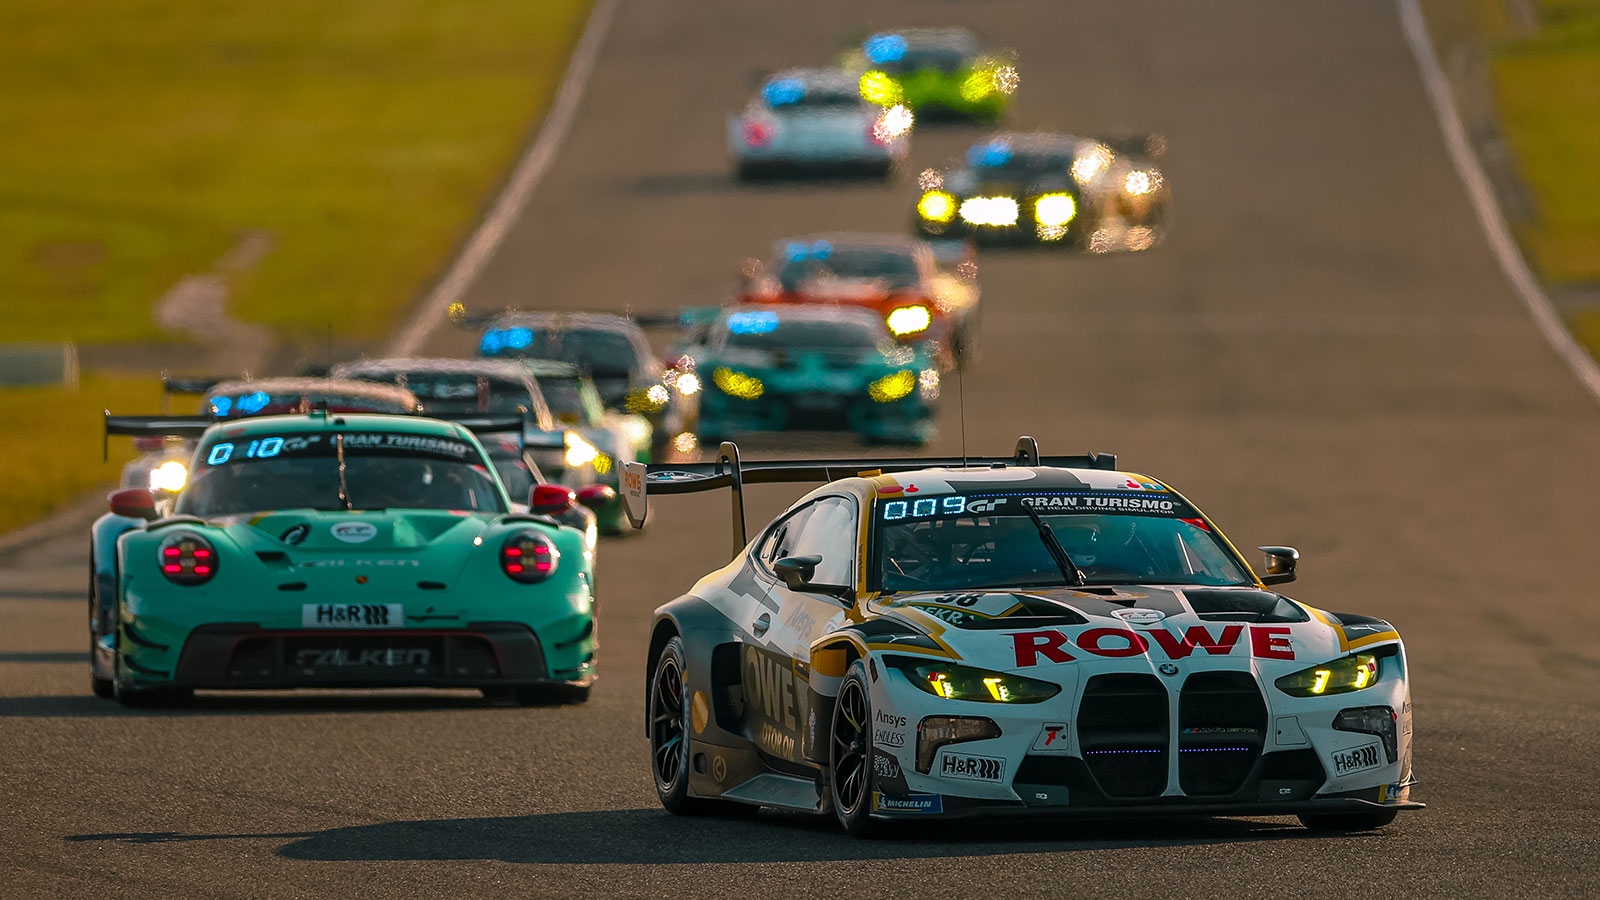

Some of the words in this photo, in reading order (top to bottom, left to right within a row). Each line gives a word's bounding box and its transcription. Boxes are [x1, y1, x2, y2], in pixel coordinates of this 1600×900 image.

[329, 434, 381, 446] GRAN
[386, 435, 466, 454] TURISMO
[883, 497, 966, 520] 009
[1020, 497, 1081, 507] GRAN
[1083, 497, 1173, 510] TURISMO
[1118, 507, 1175, 515] SIMULATOR
[316, 605, 362, 624] H&R
[1008, 624, 1296, 668] ROWE
[296, 648, 431, 667] FALKEN
[744, 645, 796, 732] OWE
[876, 709, 907, 729] Ansys
[875, 729, 905, 746] ENDLESS
[942, 754, 978, 777] H&R
[1334, 749, 1363, 774] H&R
[887, 800, 932, 808] MICHELIN
